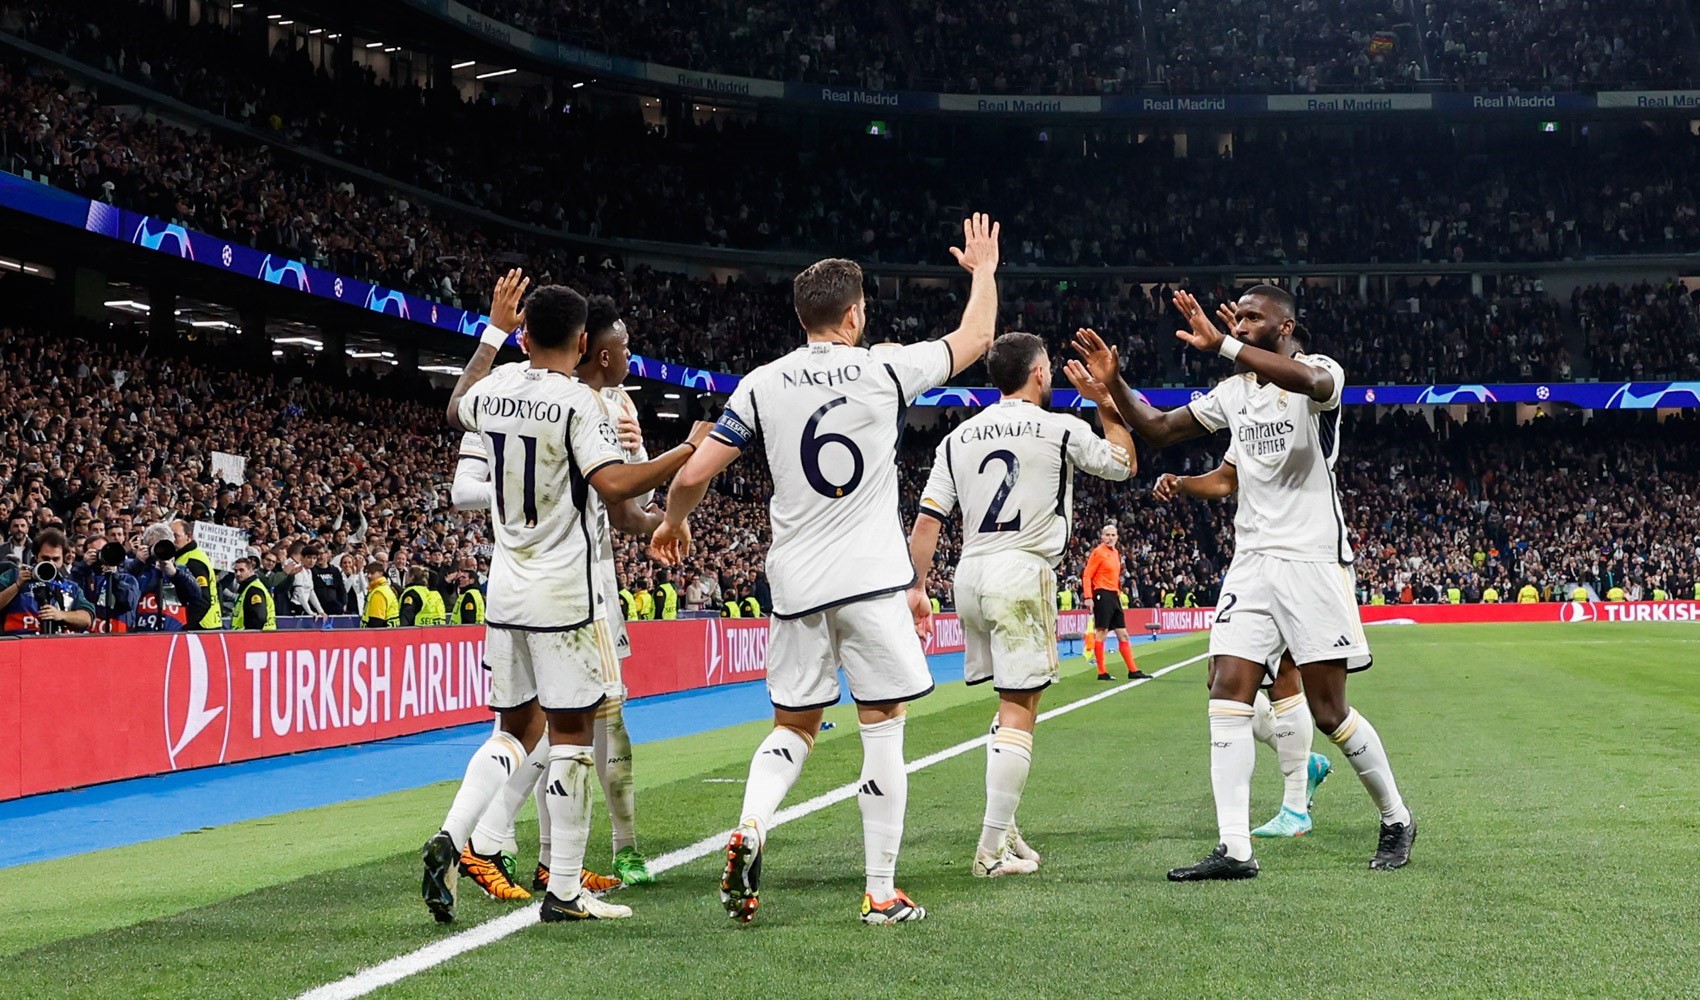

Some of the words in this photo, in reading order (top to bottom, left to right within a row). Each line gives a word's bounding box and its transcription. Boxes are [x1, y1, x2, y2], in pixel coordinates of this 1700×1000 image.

[678, 74, 701, 87] Real
[707, 79, 749, 94] Madrid
[822, 88, 850, 102] Real
[853, 92, 899, 106] Madrid
[978, 100, 1009, 112] Real
[1013, 100, 1061, 112] Madrid
[1143, 98, 1174, 111] Real
[1178, 98, 1226, 111] Madrid
[1308, 99, 1338, 110] Real
[1343, 99, 1392, 110] Madrid
[1473, 96, 1504, 108] Real
[1507, 95, 1556, 107] Madrid
[1637, 96, 1668, 107] Real
[783, 364, 862, 390] NACHO
[482, 395, 562, 423] RODRYGO
[960, 421, 1046, 444] CARVAJAL
[1238, 419, 1294, 443] Emirates
[800, 396, 864, 499] 6
[1258, 438, 1286, 456] BETTER
[484, 430, 539, 529] 11
[977, 449, 1022, 533] 2
[1162, 611, 1192, 630] TURKISH
[1193, 610, 1217, 629] AIR
[245, 646, 391, 739] TURKISH
